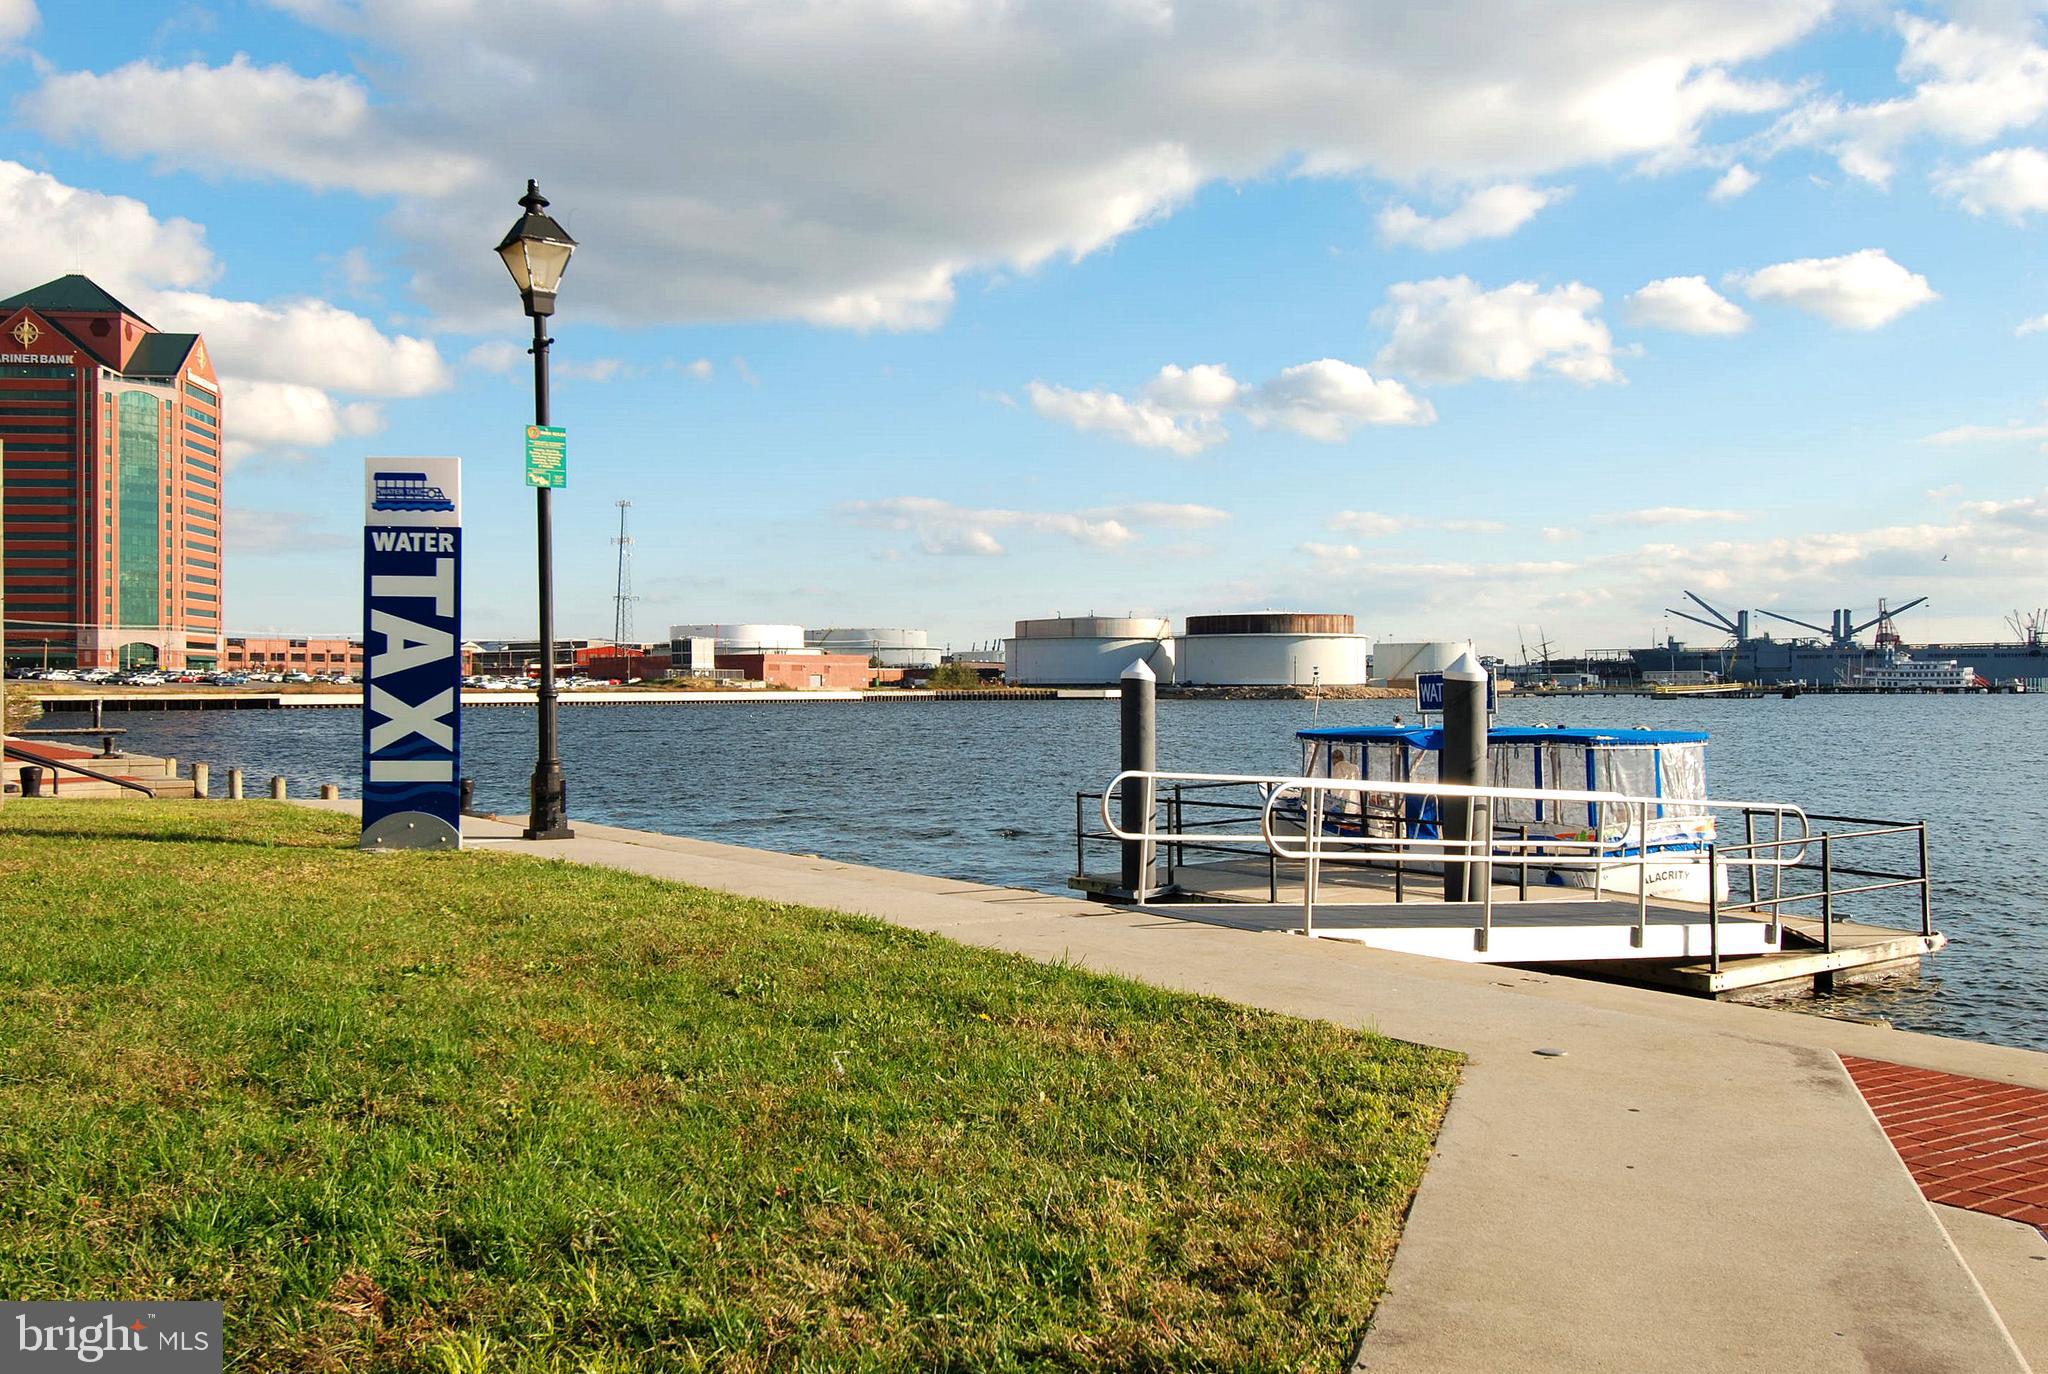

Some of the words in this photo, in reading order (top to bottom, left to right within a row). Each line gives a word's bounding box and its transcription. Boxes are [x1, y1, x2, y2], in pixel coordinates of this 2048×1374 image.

[0, 354, 39, 364] RINER
[40, 354, 75, 364] BANK
[371, 532, 455, 553] WATER
[370, 557, 454, 782] TAXI
[1420, 683, 1444, 702] WAT
